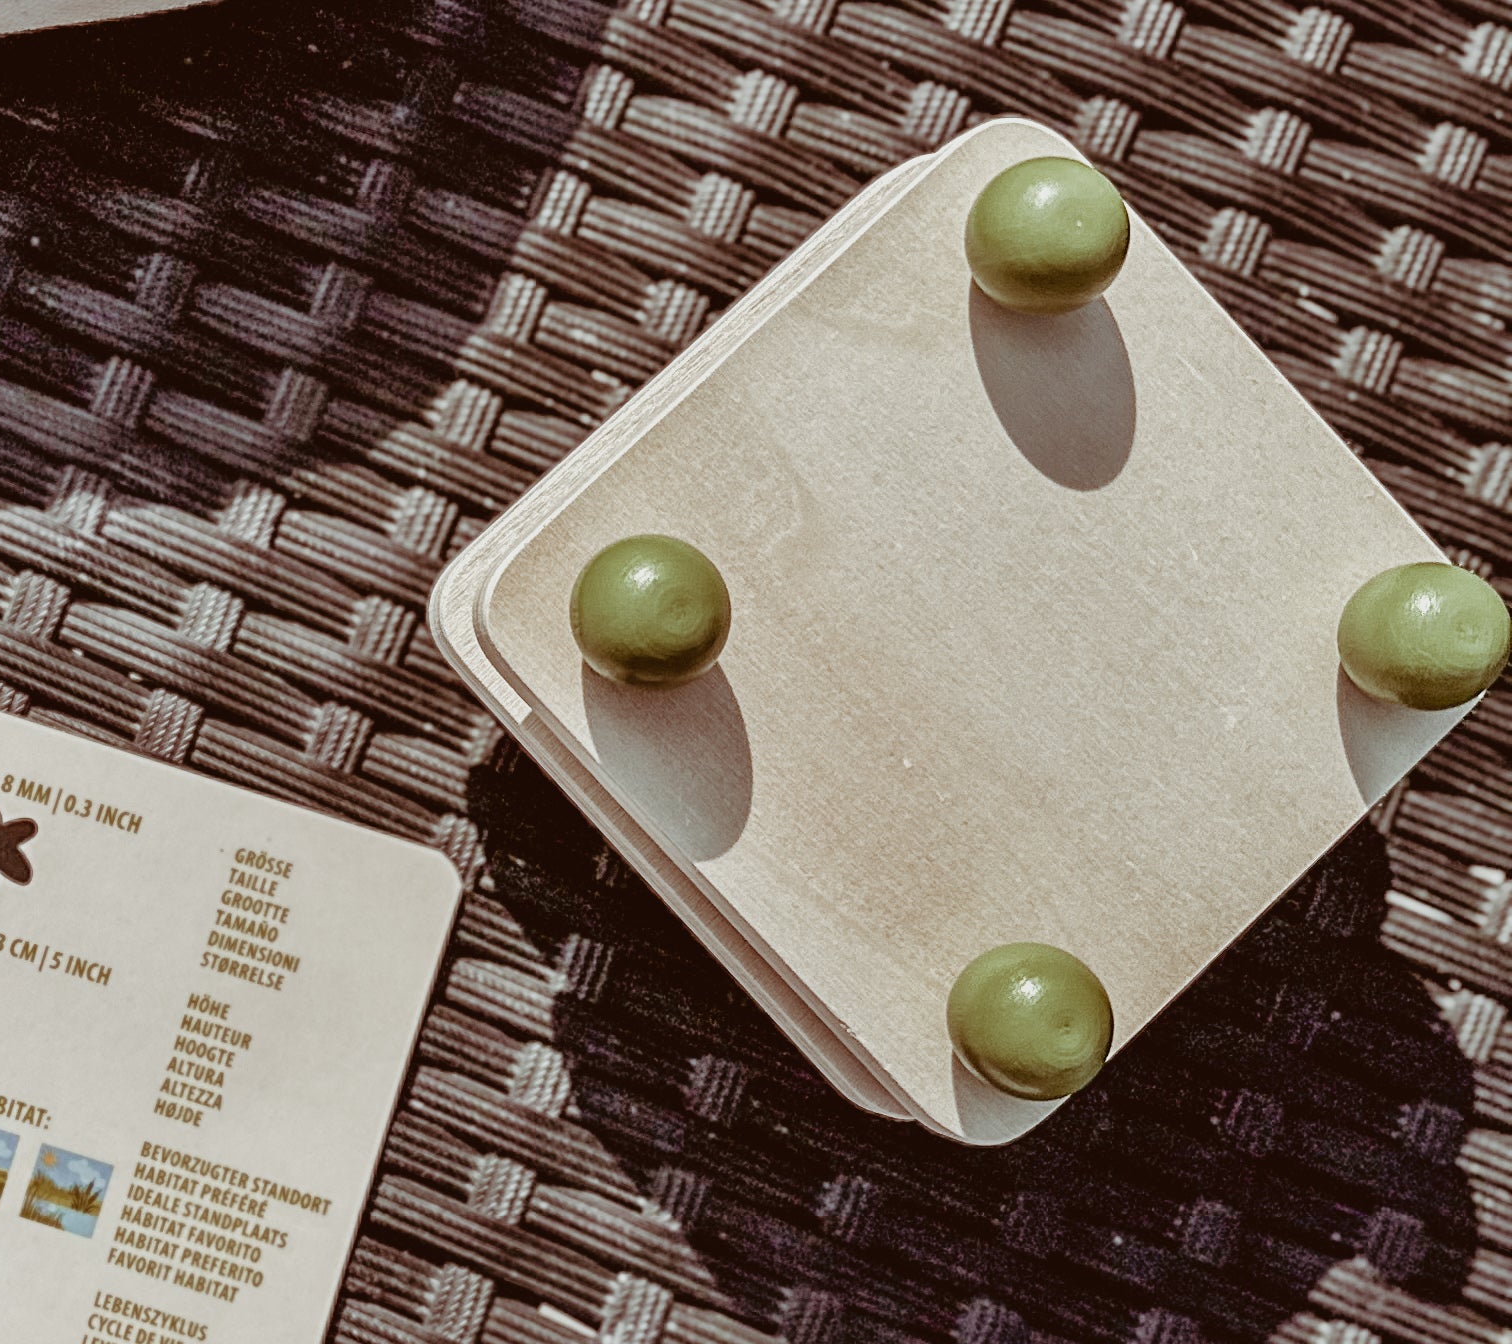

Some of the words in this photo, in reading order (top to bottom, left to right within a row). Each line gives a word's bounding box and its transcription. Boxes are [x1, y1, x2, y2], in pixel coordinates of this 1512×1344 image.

[1, 775, 14, 794] 8
[16, 778, 51, 805] MM
[64, 795, 92, 817] 0.3
[96, 804, 142, 834] INCH
[235, 848, 293, 879] GRÖSSE
[229, 868, 278, 897] TAILLE
[221, 890, 290, 924] GROOTTE
[216, 909, 278, 942] TAMAÑO
[10, 939, 38, 963] CM
[49, 952, 63, 969] 5
[65, 955, 112, 986] INCH
[208, 931, 300, 973] DIMENSIONI
[200, 952, 284, 991] STØRRELSE
[187, 993, 230, 1020] HÖHE
[181, 1015, 252, 1050] HAUTEUR
[174, 1035, 235, 1068] HOOGTE
[166, 1057, 224, 1088] ALTURA
[160, 1078, 222, 1110] ALTEZZA
[154, 1098, 203, 1127] HØJDE
[134, 1162, 199, 1195] HABITAT
[200, 1184, 267, 1218] PRÉFÉRÉ
[141, 1141, 249, 1189] BEVORZUGTER
[251, 1177, 332, 1215] STANDORT
[128, 1184, 180, 1213] IDEALE
[183, 1202, 288, 1248] STANDPLAATS
[114, 1227, 179, 1259] HABITAT
[181, 1248, 264, 1287] PREFERITO
[188, 1227, 261, 1263] FAVORITO
[108, 1248, 172, 1280] FAVORIT
[174, 1270, 239, 1303] HABITAT
[88, 1314, 133, 1341] CYCLE
[94, 1291, 208, 1341] LEBENSZYKLUS
